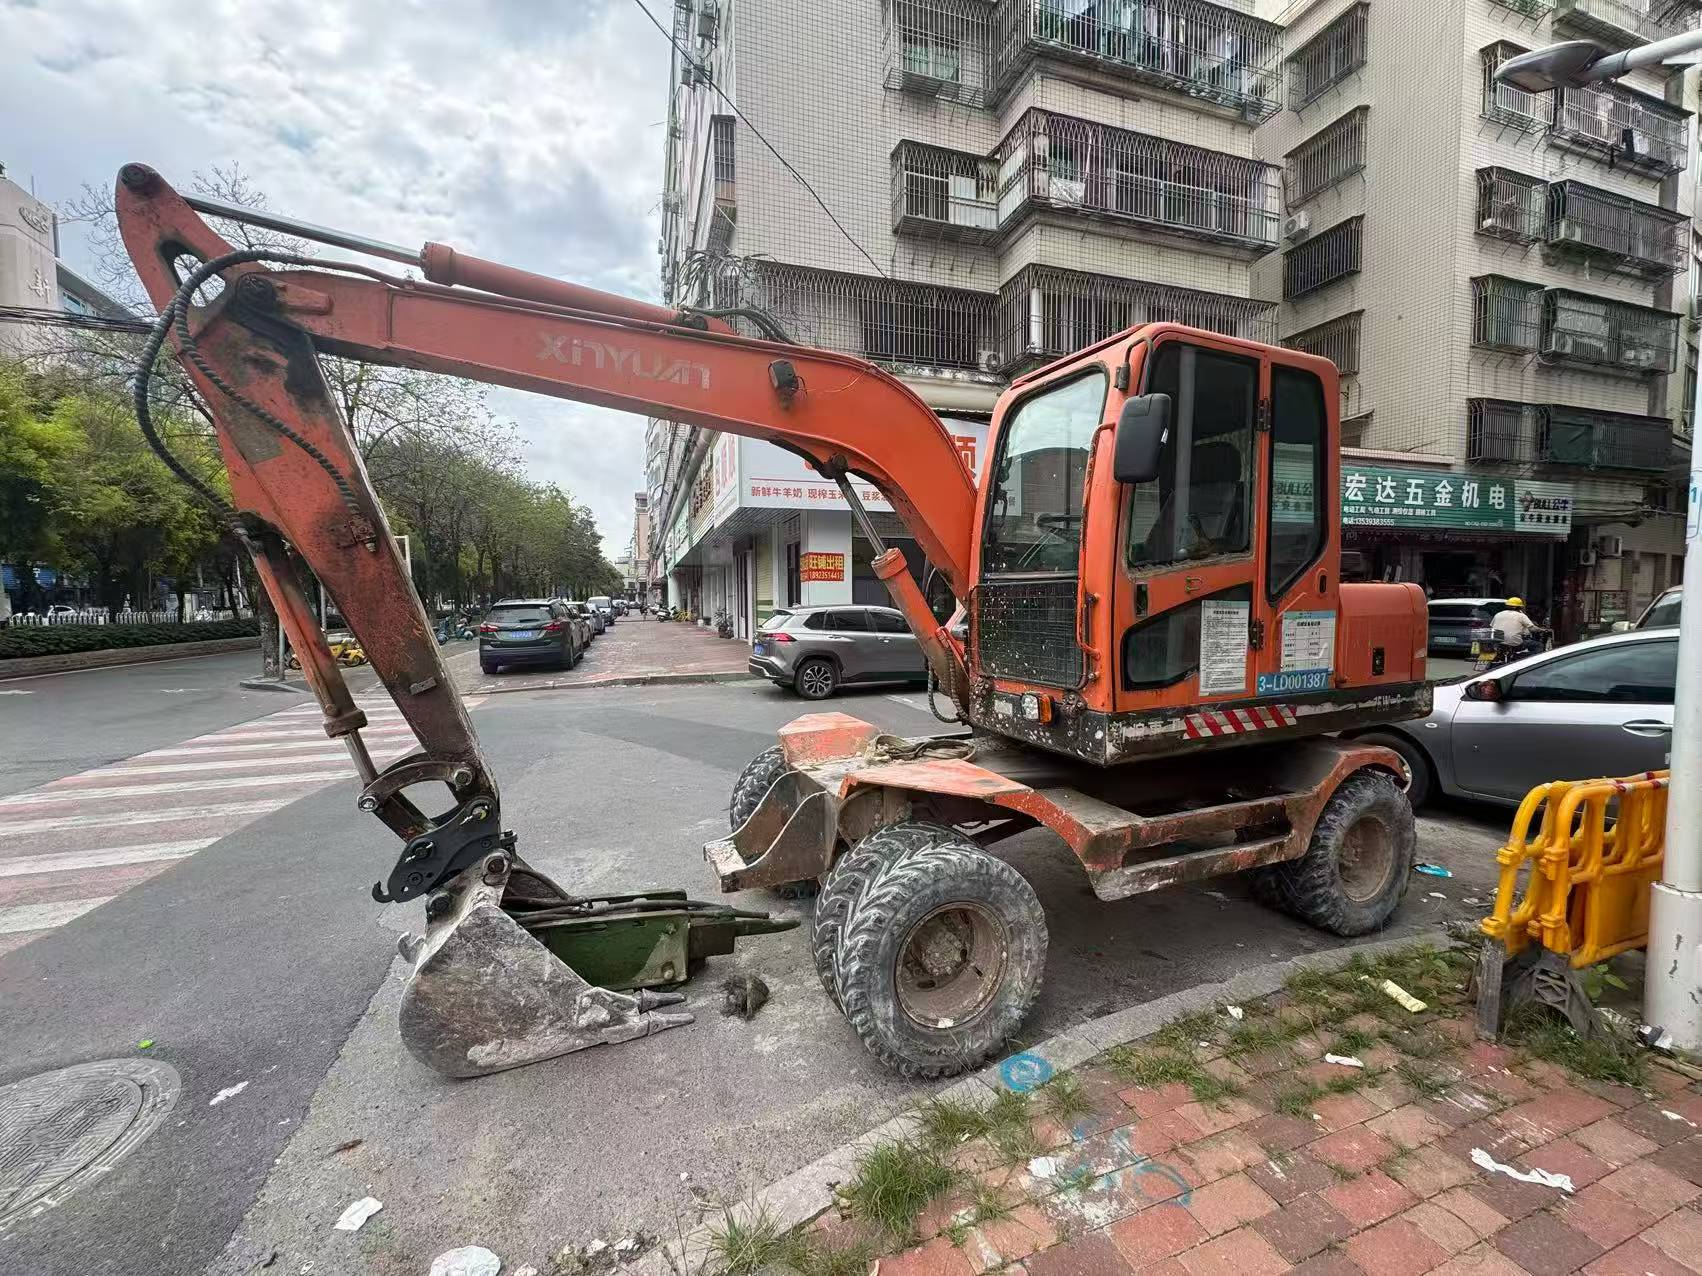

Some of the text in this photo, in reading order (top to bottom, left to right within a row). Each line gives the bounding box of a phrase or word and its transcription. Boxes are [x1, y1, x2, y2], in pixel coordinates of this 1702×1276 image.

[751, 486, 802, 498] 新鲜牛羊奶
[1344, 473, 1506, 510] 宏达五金机电
[1258, 672, 1328, 693] 3-LD001387
